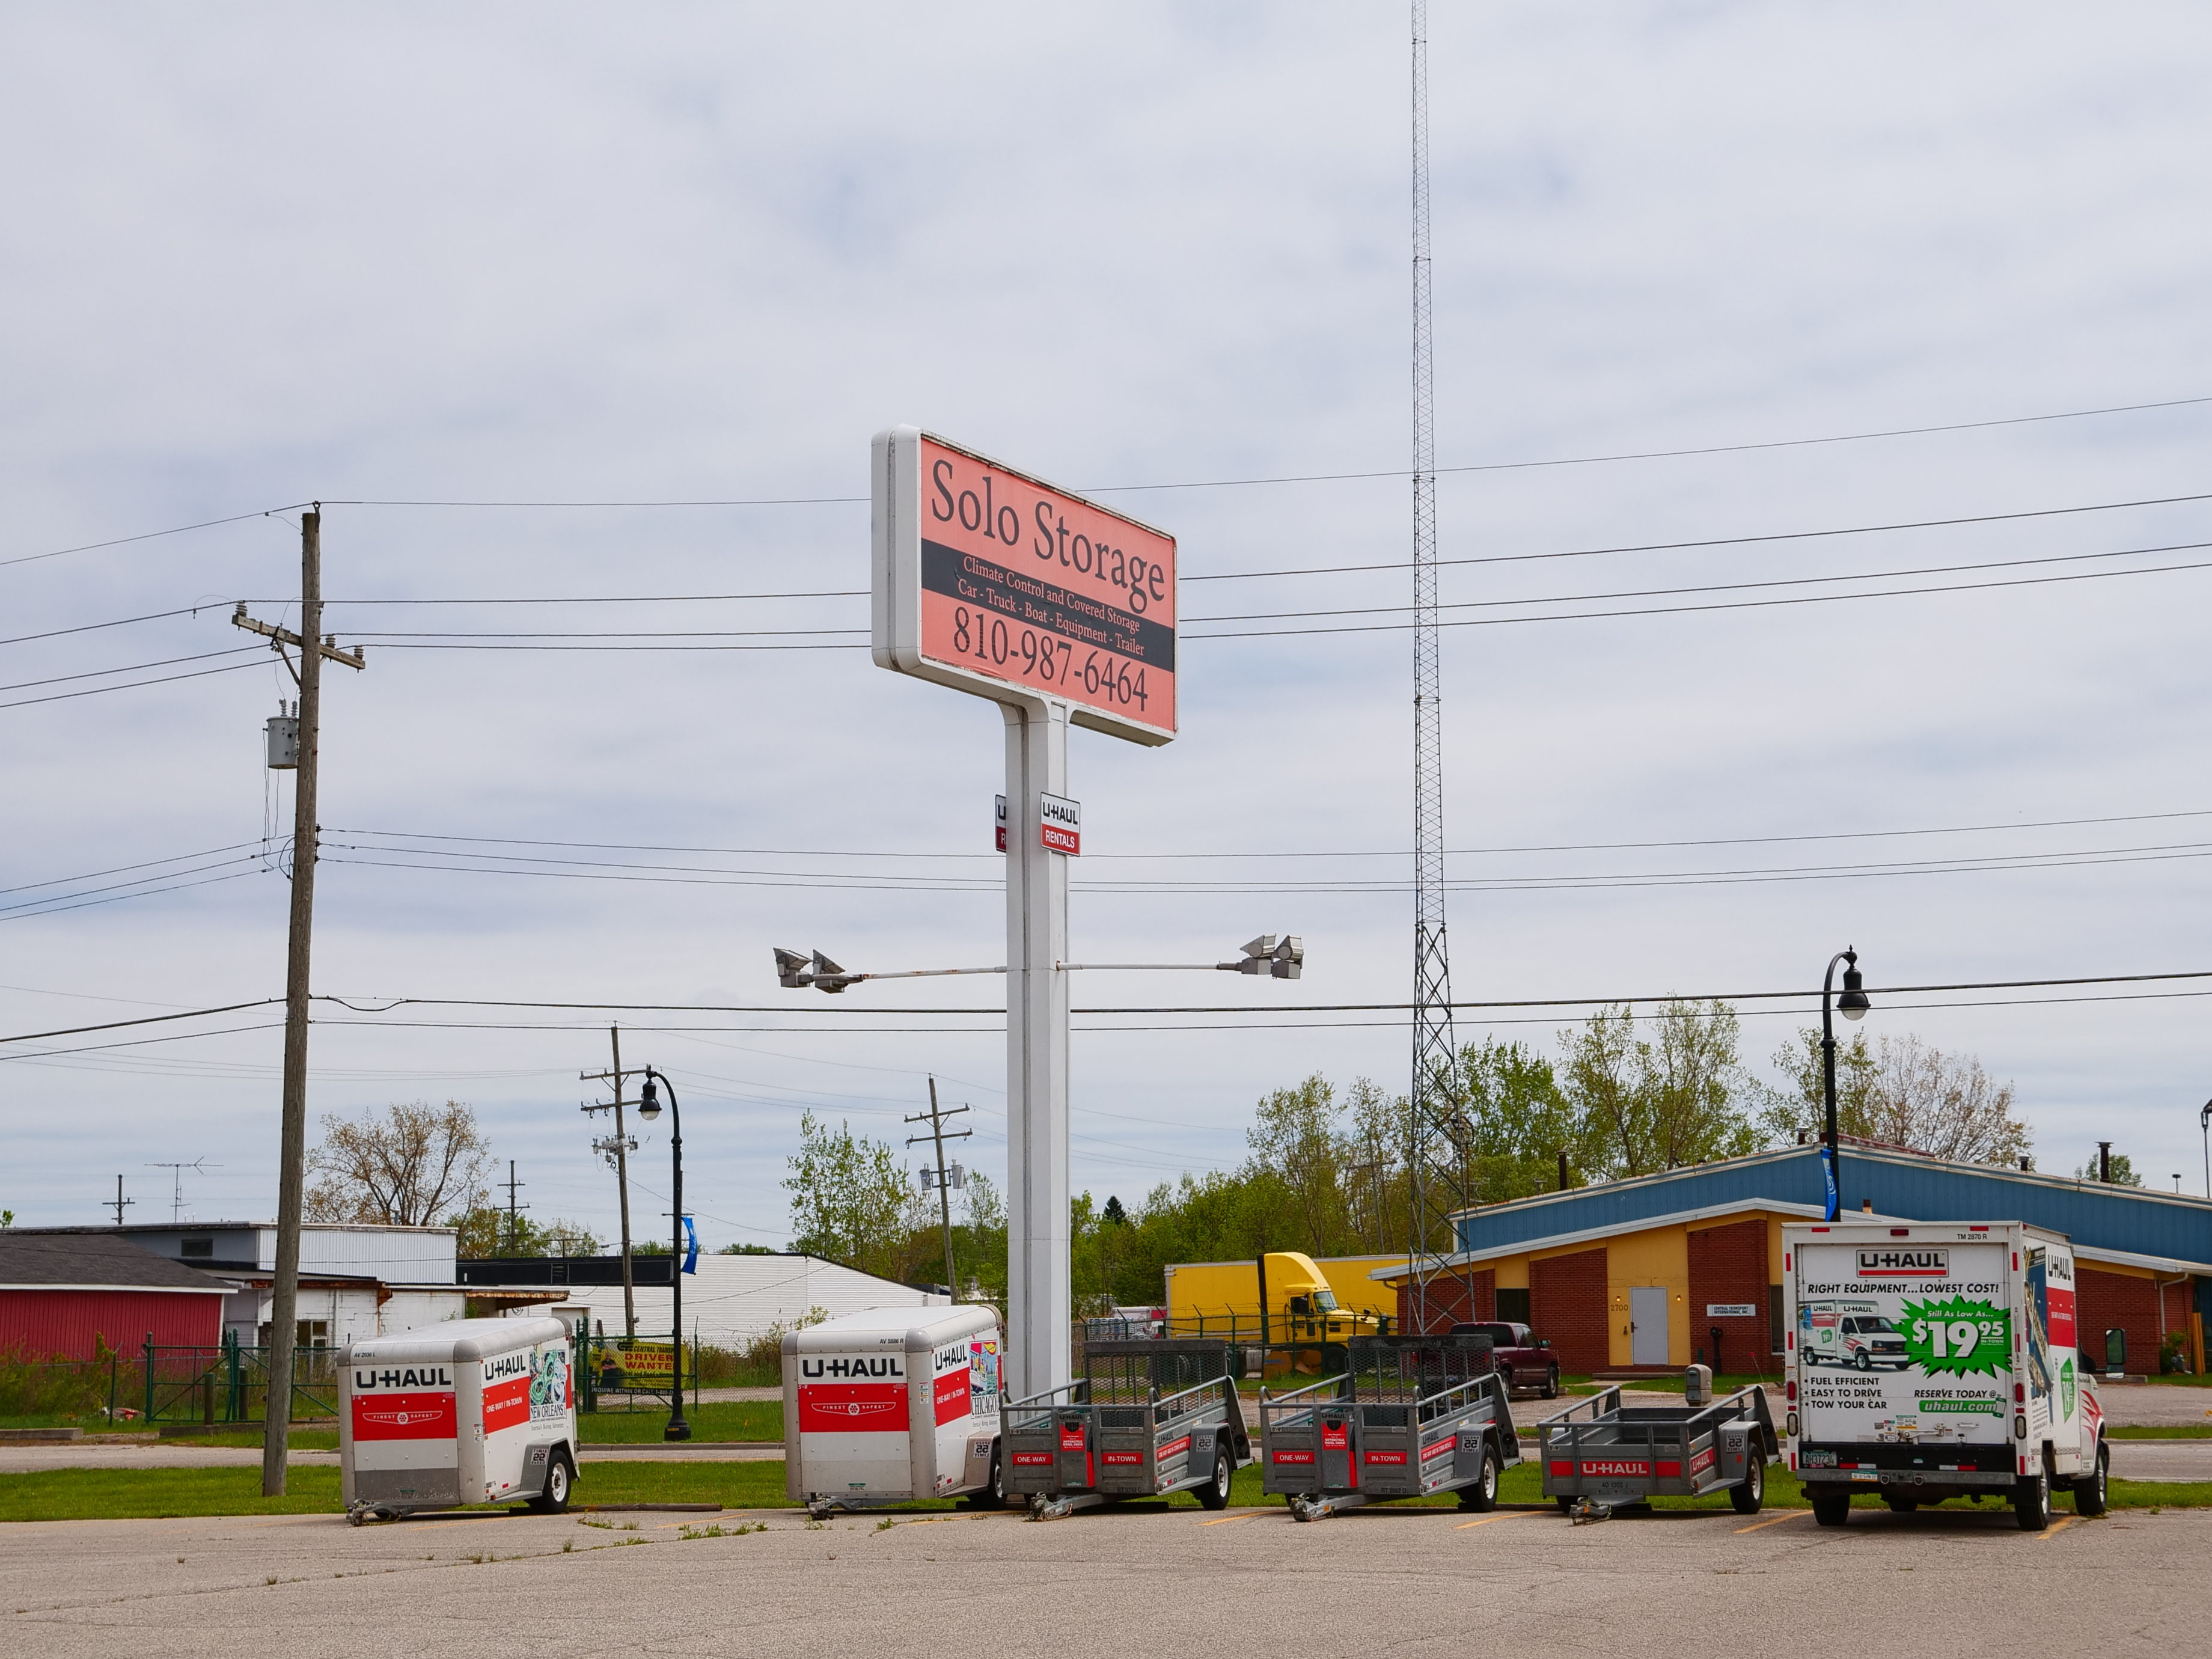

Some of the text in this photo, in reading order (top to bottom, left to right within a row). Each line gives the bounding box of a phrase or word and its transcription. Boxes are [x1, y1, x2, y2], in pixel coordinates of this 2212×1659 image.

[932, 459, 1165, 614] Solo Storage
[964, 555, 1140, 634] Climate Control and Covered Storage
[958, 578, 977, 599] Car
[986, 587, 1017, 613] Truck
[1025, 603, 1048, 623] Boat
[1056, 613, 1107, 644] Equipment
[1115, 634, 1144, 656] Trailer
[953, 606, 1149, 712] 810-987-6464
[1043, 801, 1078, 825] U-HAUL
[1046, 830, 1075, 848] RENTALS
[1860, 1253, 1945, 1268] U-HAUL
[2048, 1254, 2071, 1281] U-HAUL
[1808, 1284, 1841, 1294] RIGHT
[1967, 1283, 1999, 1293] COST!
[625, 1353, 673, 1361] DRIVER
[625, 1361, 672, 1370] WANTE
[935, 1344, 967, 1370] U-HAUL
[485, 1354, 526, 1381] U-HAUL
[802, 1358, 903, 1377] U-HAUL
[356, 1368, 451, 1389] U-HAUL
[486, 1402, 504, 1413] ONE-WAY
[506, 1396, 522, 1408] IN-TOWN
[530, 1404, 563, 1419] NEW ORLEANS
[971, 1395, 996, 1415] CHICAGO
[1925, 1401, 1996, 1411] uhaul.com
[1583, 1463, 1647, 1473] U-HAUL
[1693, 1453, 1709, 1471] U-HAUL
[1806, 1455, 1834, 1464] AH37234
